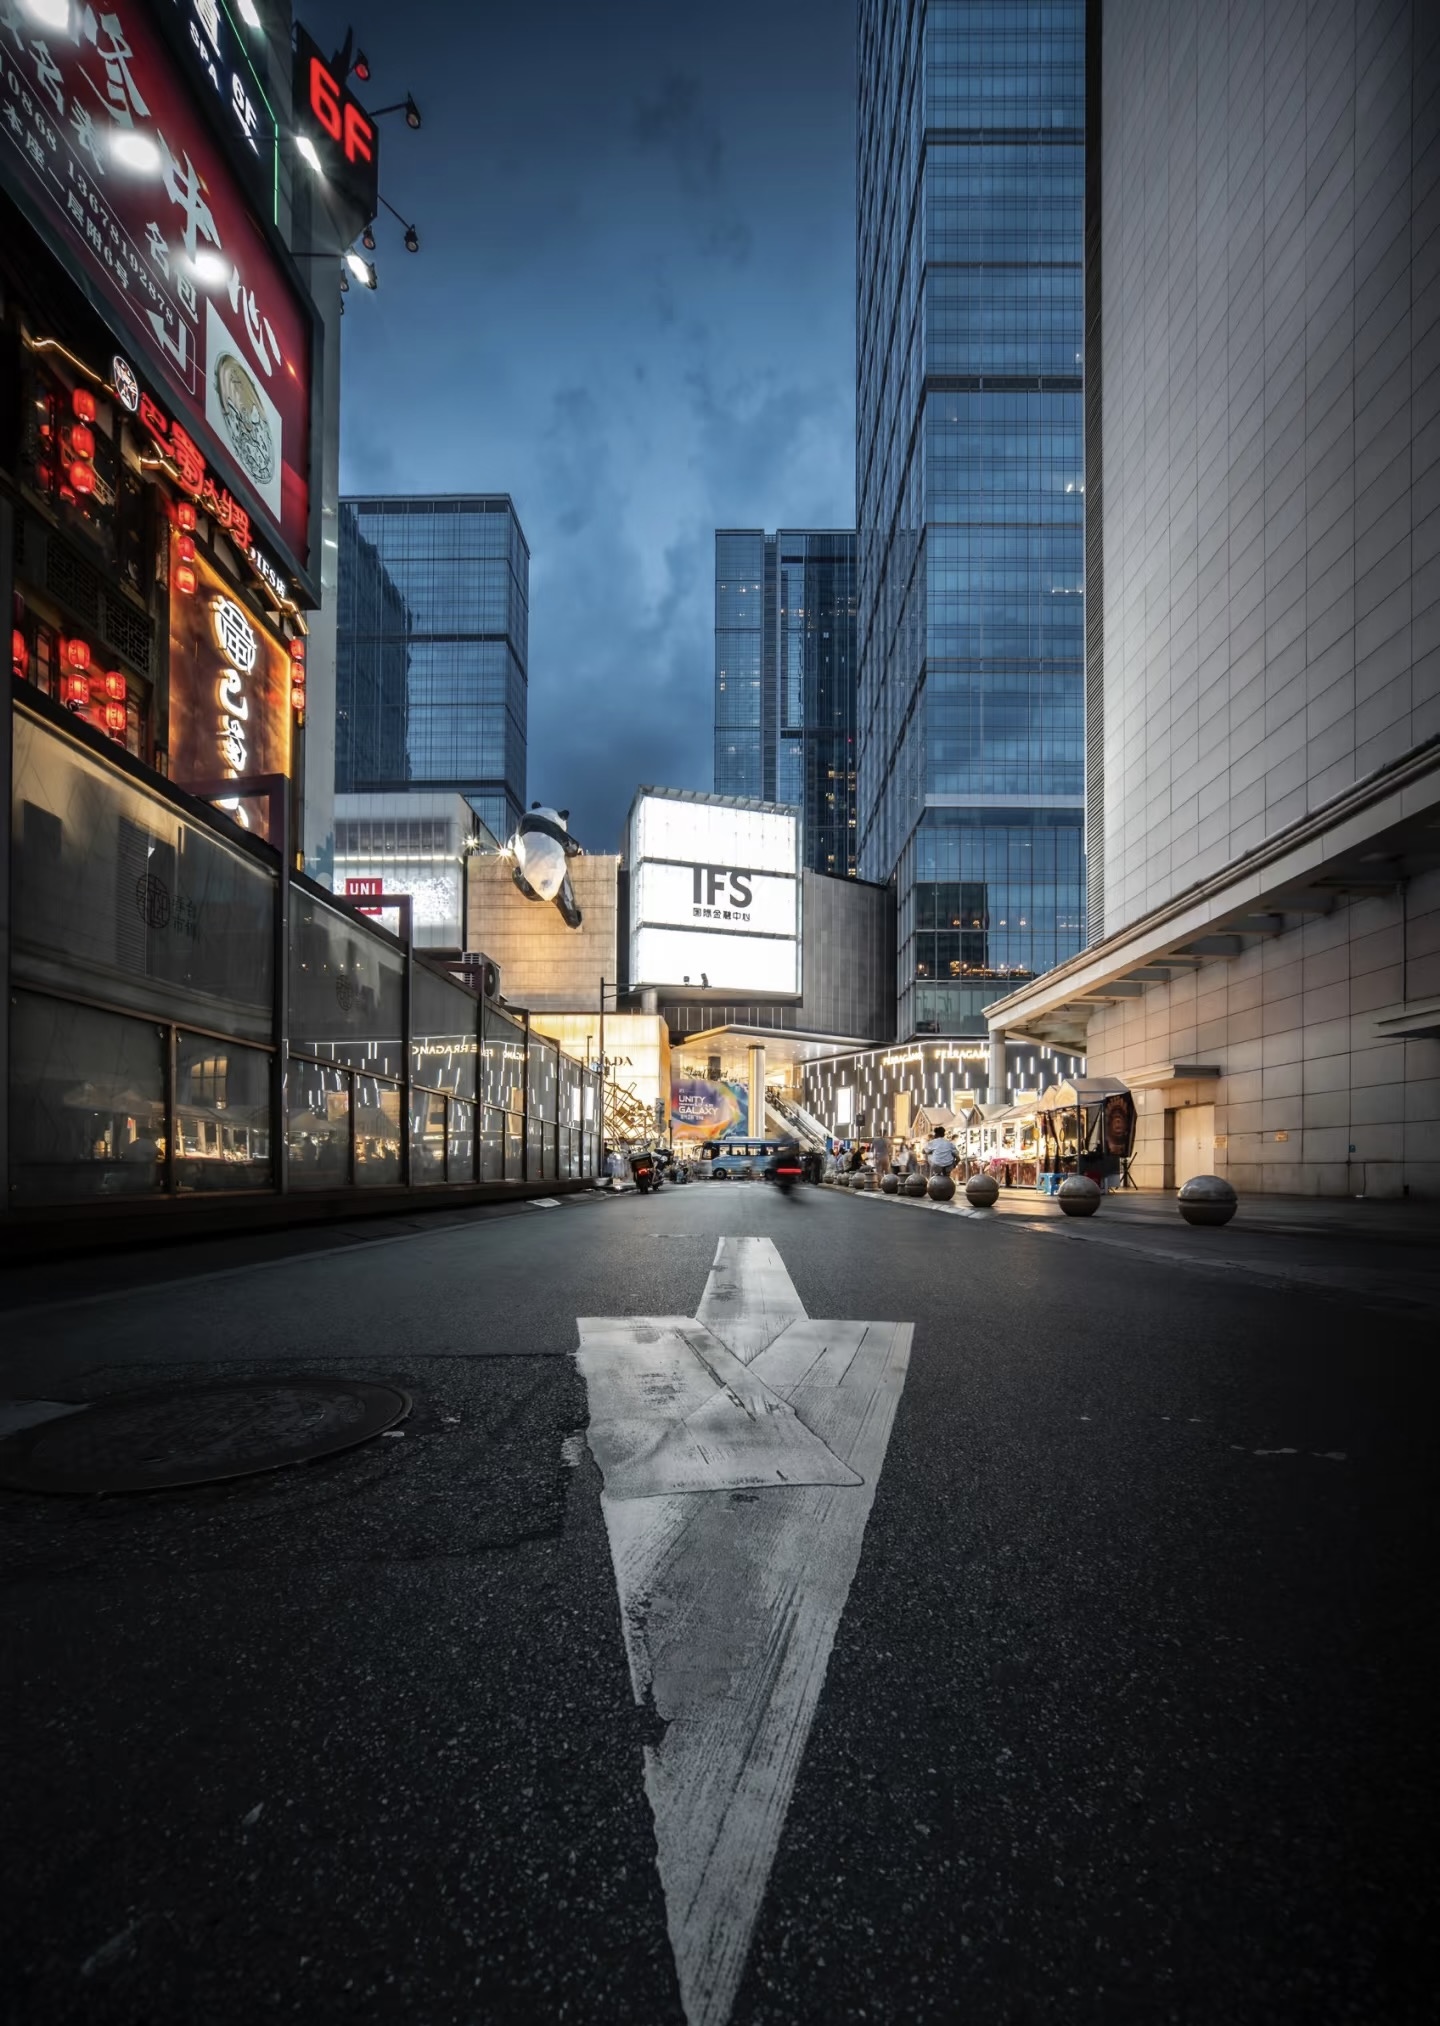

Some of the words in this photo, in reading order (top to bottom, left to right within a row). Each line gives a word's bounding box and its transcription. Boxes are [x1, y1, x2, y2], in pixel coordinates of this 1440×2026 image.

[310, 56, 372, 163] 6F
[349, 882, 376, 895] UNI
[693, 866, 752, 908] IFS
[678, 1095, 706, 1105] UNITY
[678, 1105, 720, 1116] GALAXY
